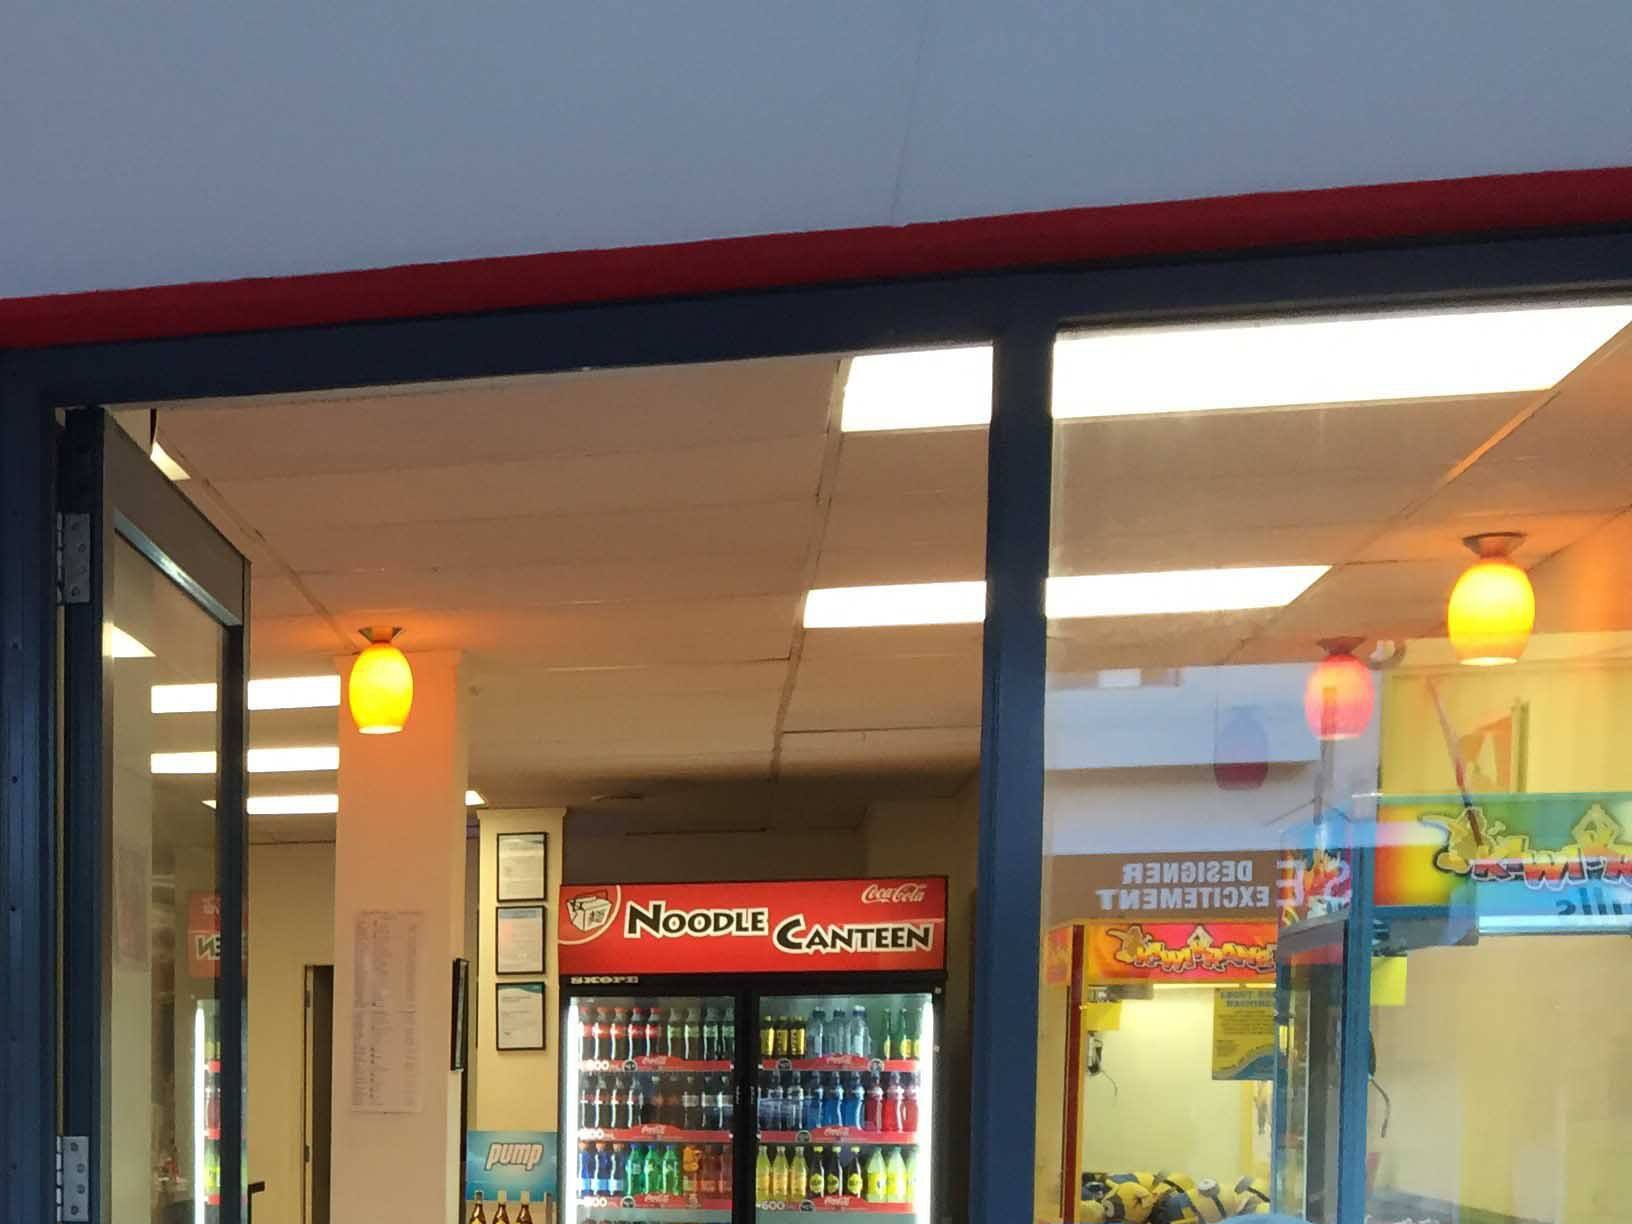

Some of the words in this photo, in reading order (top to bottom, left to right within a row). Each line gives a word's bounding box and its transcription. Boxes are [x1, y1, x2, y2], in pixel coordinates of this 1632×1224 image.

[624, 900, 768, 938] NOODLE
[772, 914, 934, 955] CANTEEN
[484, 1142, 544, 1171] pump
